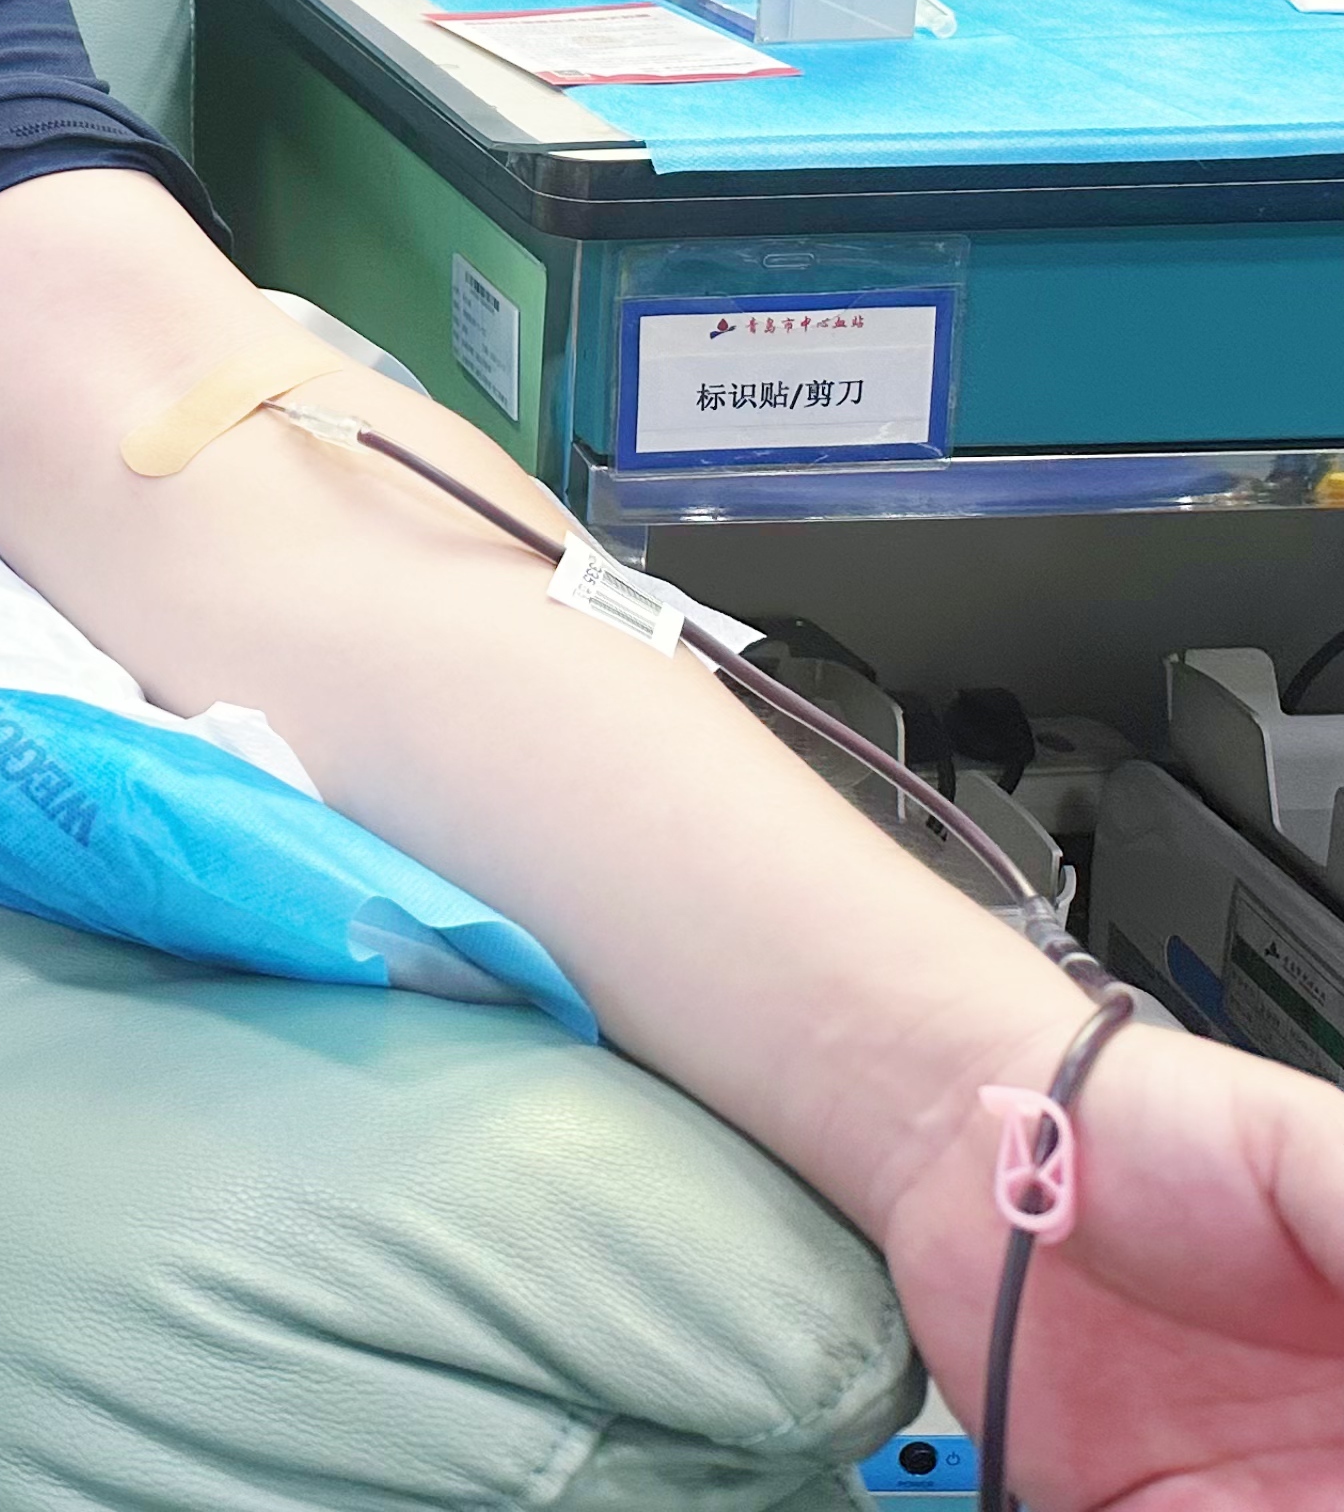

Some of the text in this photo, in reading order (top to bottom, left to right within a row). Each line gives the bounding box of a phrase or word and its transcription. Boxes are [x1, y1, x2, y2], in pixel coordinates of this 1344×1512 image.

[745, 314, 864, 334] 青岛市中心血站
[696, 379, 864, 411] 标识贴/剪刀
